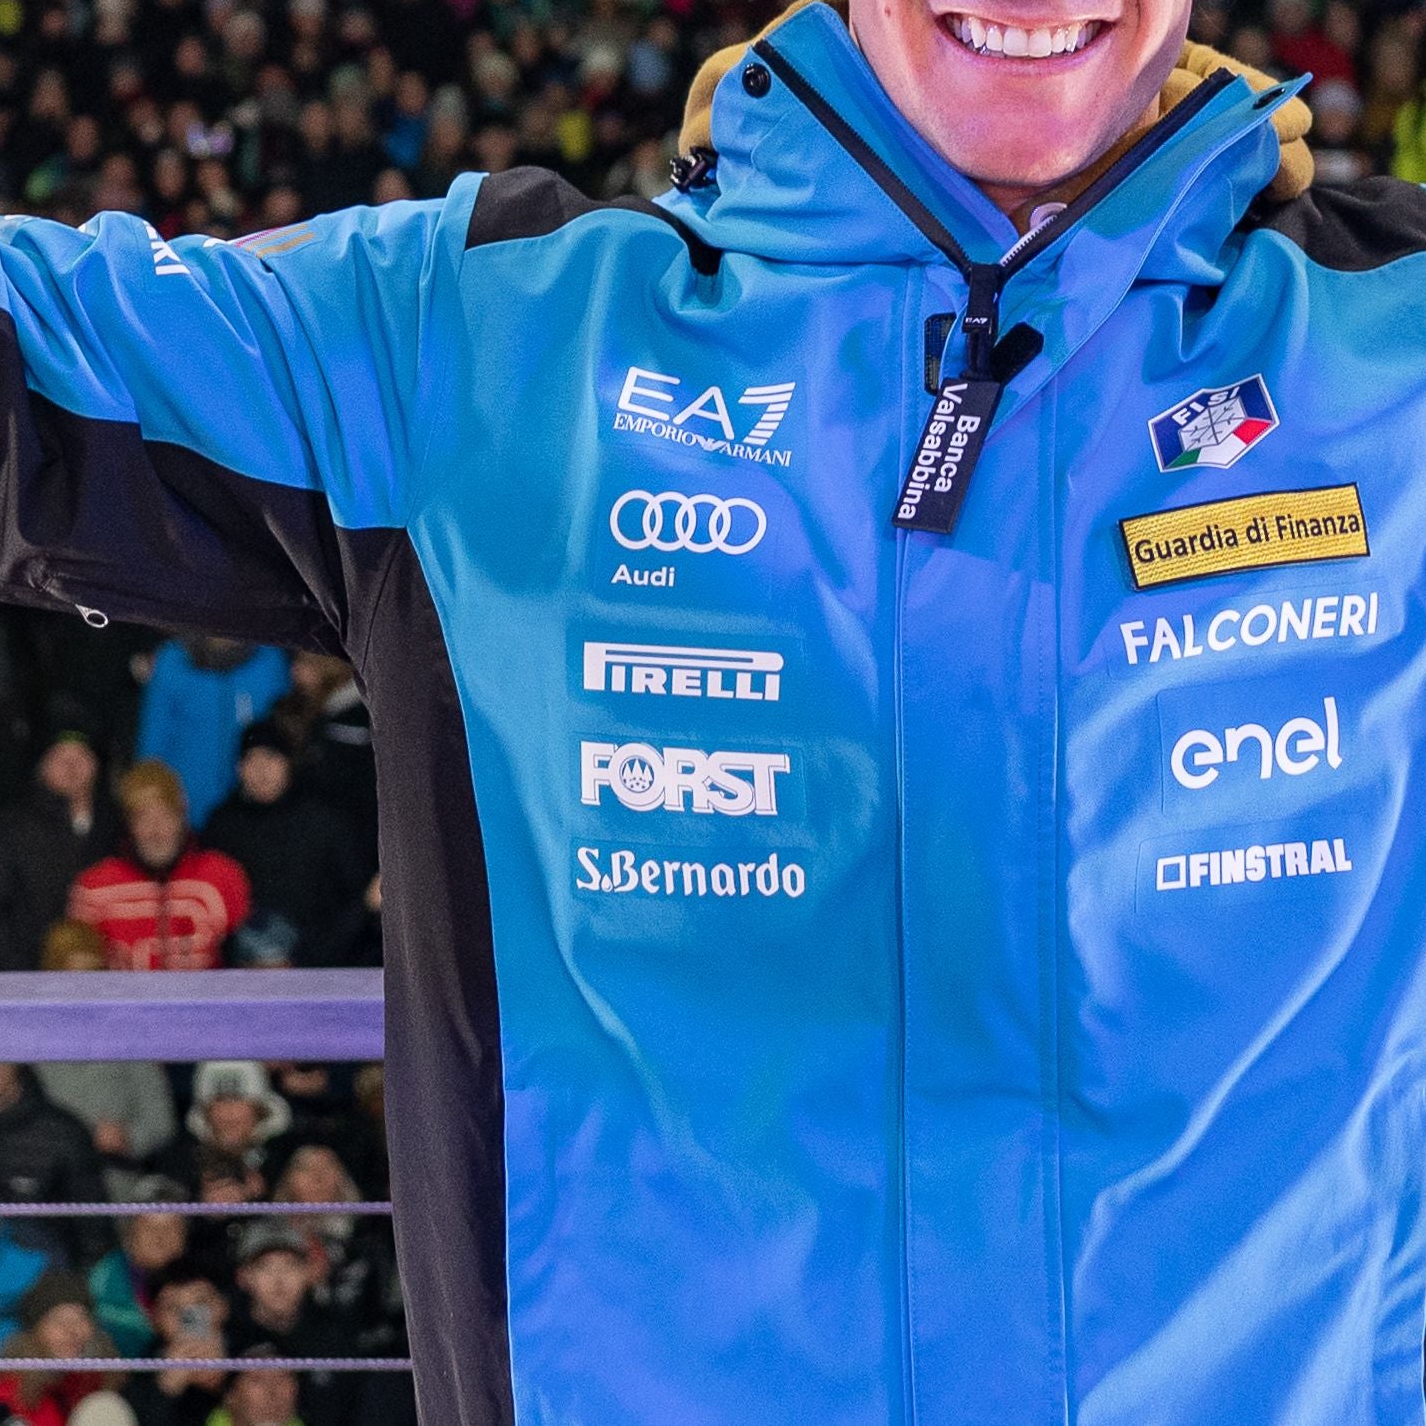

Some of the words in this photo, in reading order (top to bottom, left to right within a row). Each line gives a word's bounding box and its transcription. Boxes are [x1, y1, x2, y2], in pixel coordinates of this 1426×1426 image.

[617, 366, 796, 446] EA7
[1172, 386, 1241, 427] FISI
[613, 412, 697, 447] EMPORIO
[720, 442, 793, 468] ARMANI
[897, 382, 968, 520] Valsabbina
[934, 414, 981, 493] Banca
[1135, 524, 1239, 563] Guardia
[1246, 517, 1270, 544] di
[1275, 512, 1360, 541] Finanza
[611, 564, 676, 587] Audi
[1120, 592, 1378, 665] FALCONERI
[583, 641, 784, 701] PIRELLI
[1170, 696, 1343, 790] enel
[580, 740, 791, 816] FORST
[576, 846, 805, 898] S.Bernardo
[1189, 838, 1353, 887] FINSTRAL
